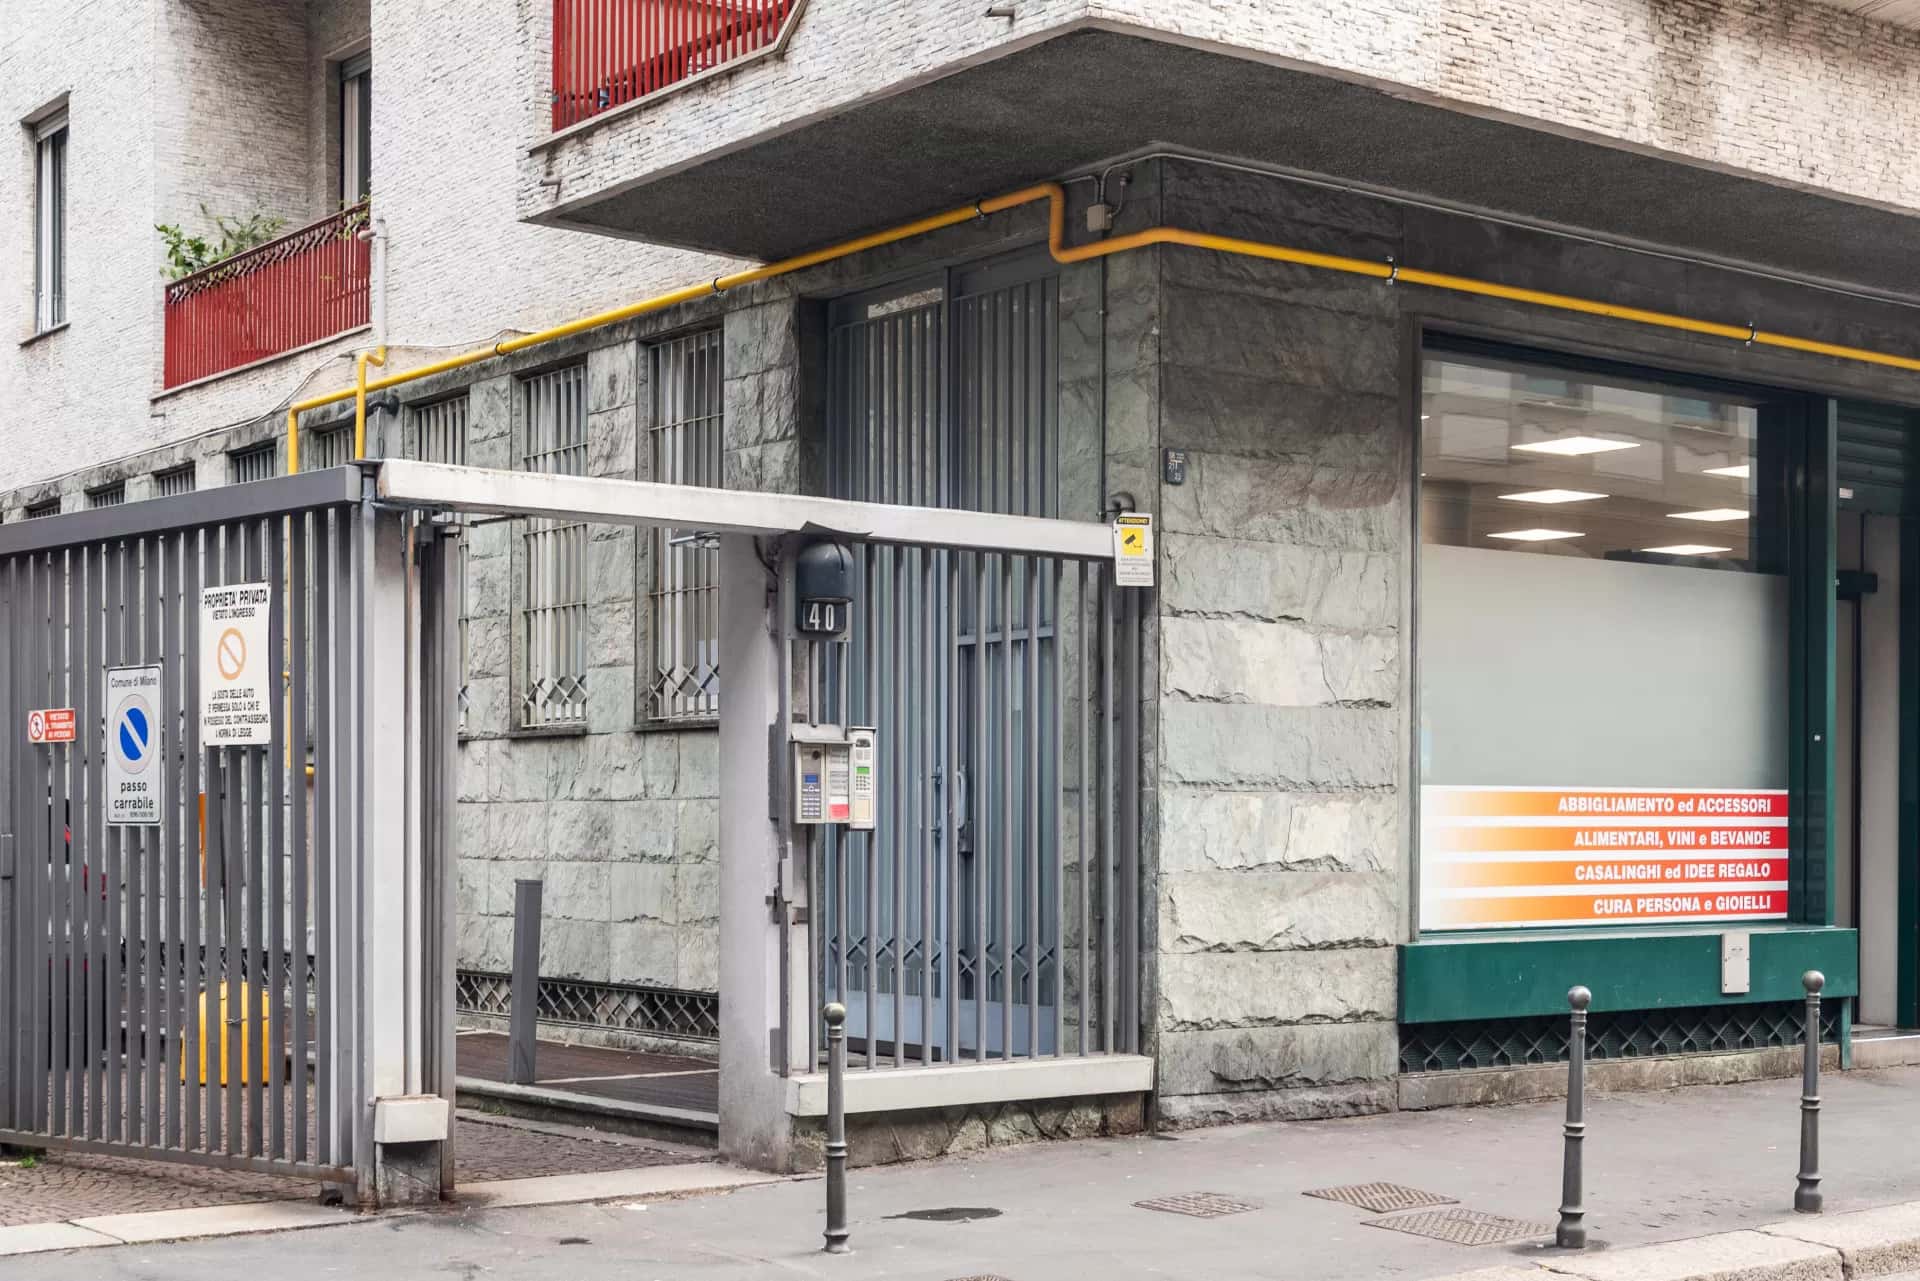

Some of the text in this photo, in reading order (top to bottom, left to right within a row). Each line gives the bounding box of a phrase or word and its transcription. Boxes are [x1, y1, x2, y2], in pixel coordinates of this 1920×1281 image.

[204, 588, 267, 608] PROPRIETA' PRIVATA
[212, 607, 255, 620] VIETATO L'INGRESSO
[809, 603, 835, 630] 40
[111, 675, 157, 688] Comune di Milano
[230, 688, 242, 699] DELLE
[243, 687, 255, 698] AUTO
[232, 701, 242, 712] SOLO
[120, 782, 147, 794] passo
[114, 796, 153, 809] carrabile
[1558, 797, 1771, 813] ABBIGLIAMENTO ed ACCESSORI
[1574, 830, 1771, 848] ALIMENTARI, VINI e BEVANDE
[1575, 863, 1771, 880] CASALINGHI ed IDEE REGALO
[1593, 895, 1771, 914] CURA PERSONA e GIOIELLI
